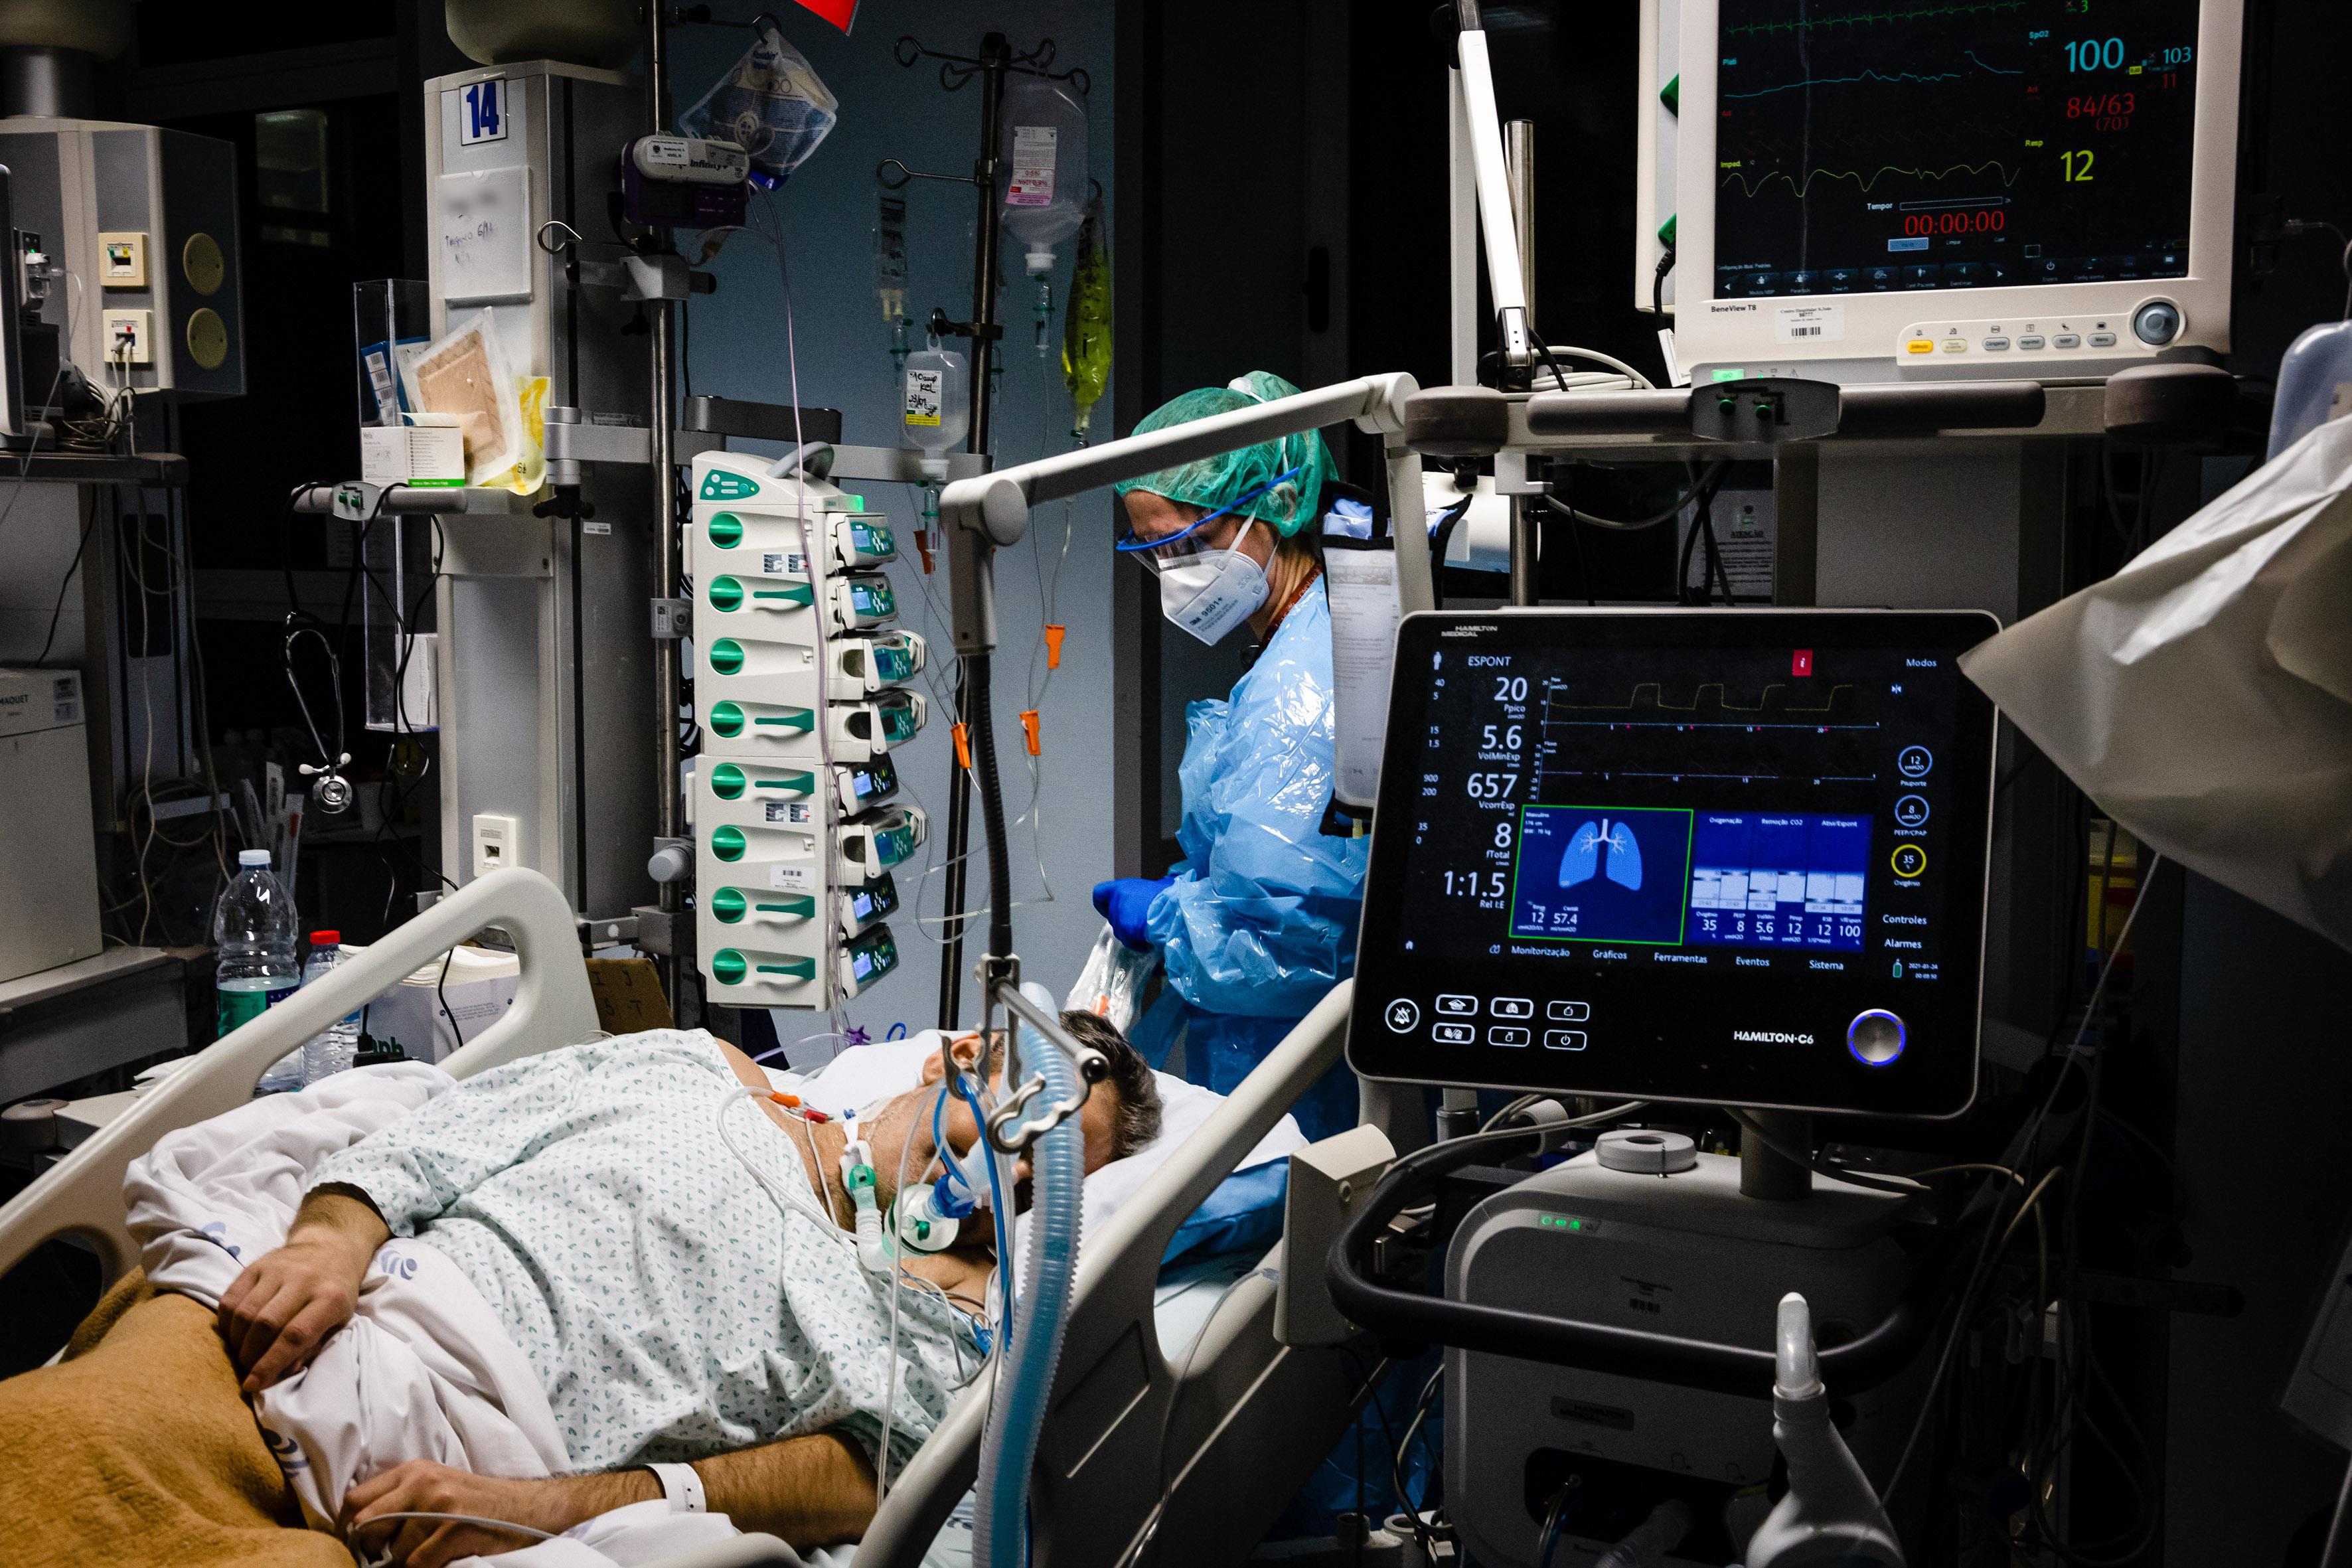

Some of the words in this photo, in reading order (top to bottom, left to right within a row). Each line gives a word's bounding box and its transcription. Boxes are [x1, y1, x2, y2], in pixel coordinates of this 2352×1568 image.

[2029, 30, 2049, 40] SpO2
[2064, 38, 2124, 72] 100
[2163, 47, 2192, 64] 103
[2162, 74, 2177, 90] 11
[467, 82, 499, 138] 14
[2067, 92, 2136, 118] 84/63
[2096, 116, 2129, 132] (70)
[2025, 139, 2043, 149] Resp
[2061, 149, 2095, 183] 12
[1867, 201, 1893, 211] Tempor
[1905, 210, 2004, 236] 00:00:00
[1711, 305, 1746, 314] BeneView
[1747, 303, 1757, 312] T8
[1468, 656, 1511, 666] ESPONT
[1907, 658, 1937, 667] Modos
[1435, 678, 1445, 687] 40
[1494, 676, 1528, 702] 20
[1504, 704, 1526, 714] Ppico
[1429, 739, 1439, 747] 1.5
[1481, 725, 1522, 750] 5.6
[1478, 751, 1520, 761] VolMinExp
[1911, 756, 1921, 765] 12
[1424, 774, 1438, 783] 900
[1467, 773, 1518, 798] 657
[1422, 787, 1437, 796] 200
[1479, 801, 1515, 811] VcorrExp
[1909, 805, 1915, 814] 8
[1418, 823, 1427, 831] 35
[1494, 823, 1512, 848] 8
[1486, 850, 1510, 859] fTotal
[1903, 855, 1915, 864] 35
[1444, 871, 1506, 898] 1:1.5
[1480, 900, 1493, 909] Rel
[1531, 912, 1545, 923] 12
[1553, 913, 1578, 925] 57.4
[1702, 919, 1717, 931] 35
[1737, 920, 1745, 932] 8
[1755, 921, 1774, 933] 5.6
[1788, 923, 1802, 935] 12
[1818, 924, 1832, 936] 12
[1839, 925, 1861, 937] 100
[1882, 915, 1928, 925] Controles
[1884, 938, 1922, 949] Alarmes
[1511, 945, 1571, 957] Monitorização
[1593, 949, 1628, 961] Gráficos
[1654, 952, 1708, 964] Ferramentas
[1735, 957, 1770, 967] Eventos
[1809, 960, 1844, 971] Sistema
